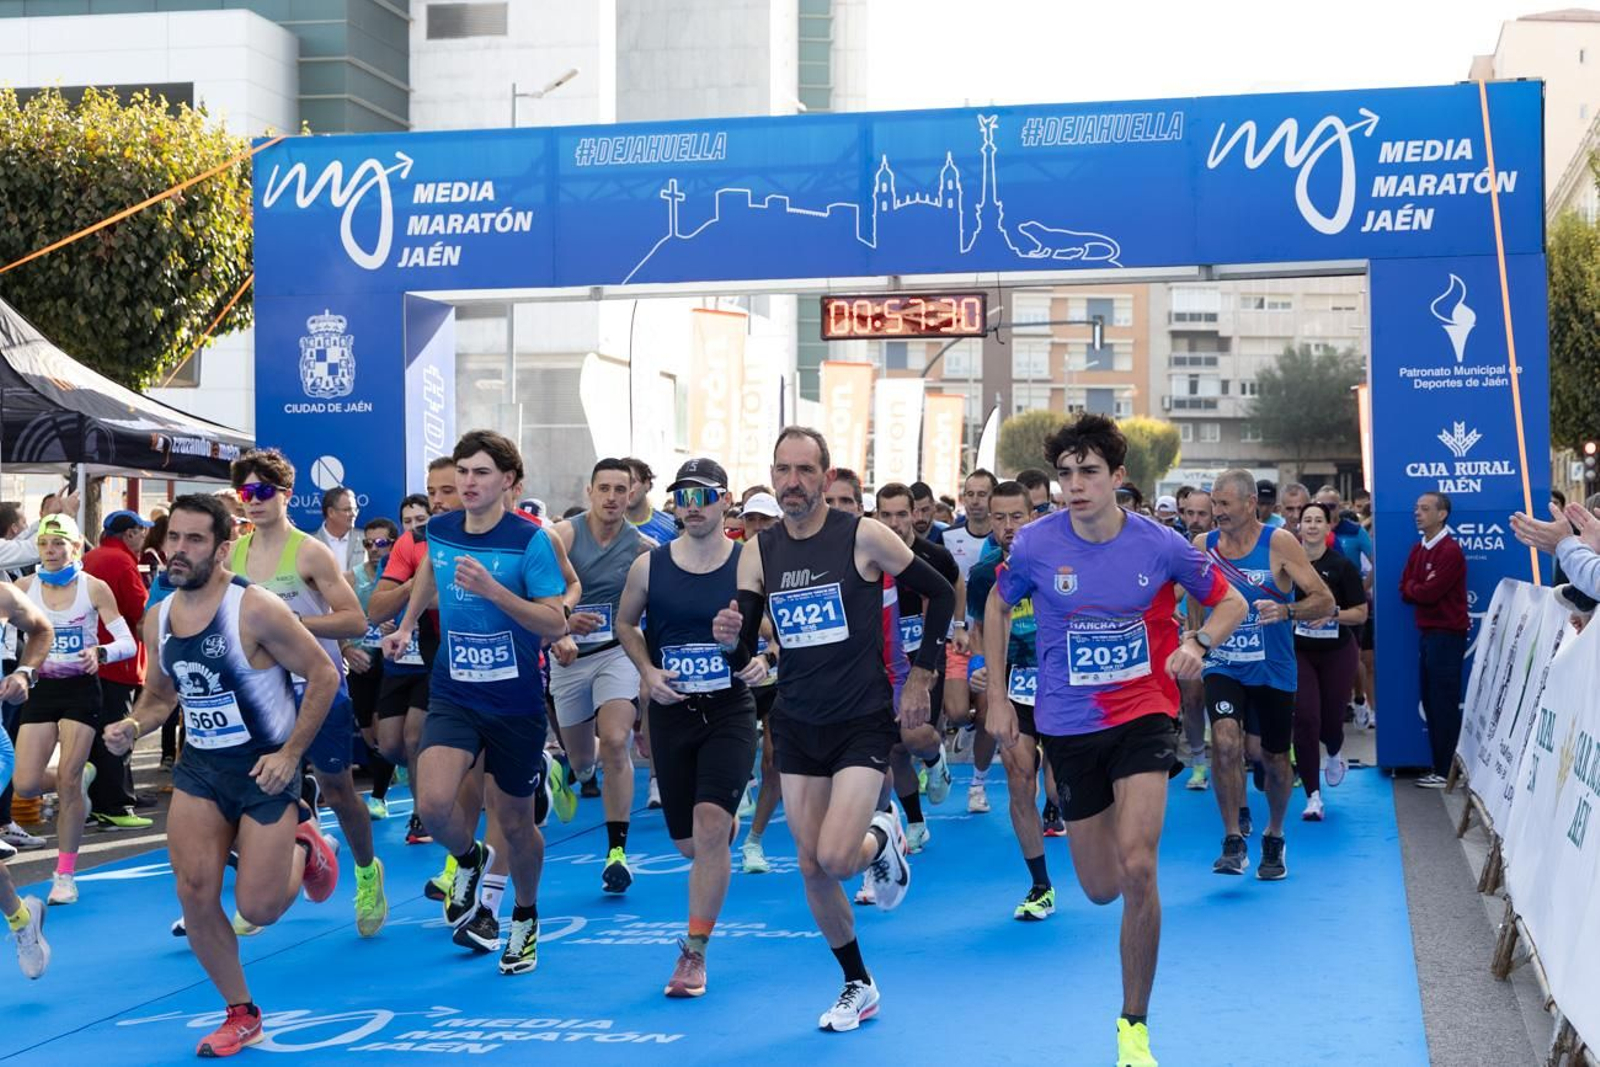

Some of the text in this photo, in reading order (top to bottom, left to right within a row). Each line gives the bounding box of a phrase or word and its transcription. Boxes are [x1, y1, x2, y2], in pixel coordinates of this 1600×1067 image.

[1021, 110, 1184, 147] #DEJAHUELLA
[576, 132, 727, 167] #DEJAHUELLA
[1378, 138, 1473, 164] MEDIA
[412, 181, 495, 204] MEDIA
[1371, 167, 1517, 198] MARATÓN
[406, 207, 533, 236] MARATÓN
[1361, 208, 1434, 233] JAÉN
[397, 242, 461, 268] JAÉN
[829, 297, 981, 335] 00:57:30
[1399, 365, 1523, 378] Patronato Municipal e
[1414, 376, 1509, 390] Deportes de Jaén
[284, 400, 373, 414] CIUDAD DE JAÉN
[1406, 461, 1516, 477] CAJA RURAL
[1437, 476, 1482, 493] JAÉN
[780, 568, 810, 589] RUN
[777, 600, 836, 627] 2421
[454, 645, 509, 665] 2085
[1075, 638, 1143, 667] 2037
[667, 656, 725, 676] 2038
[433, 1017, 614, 1030] MEDIA
